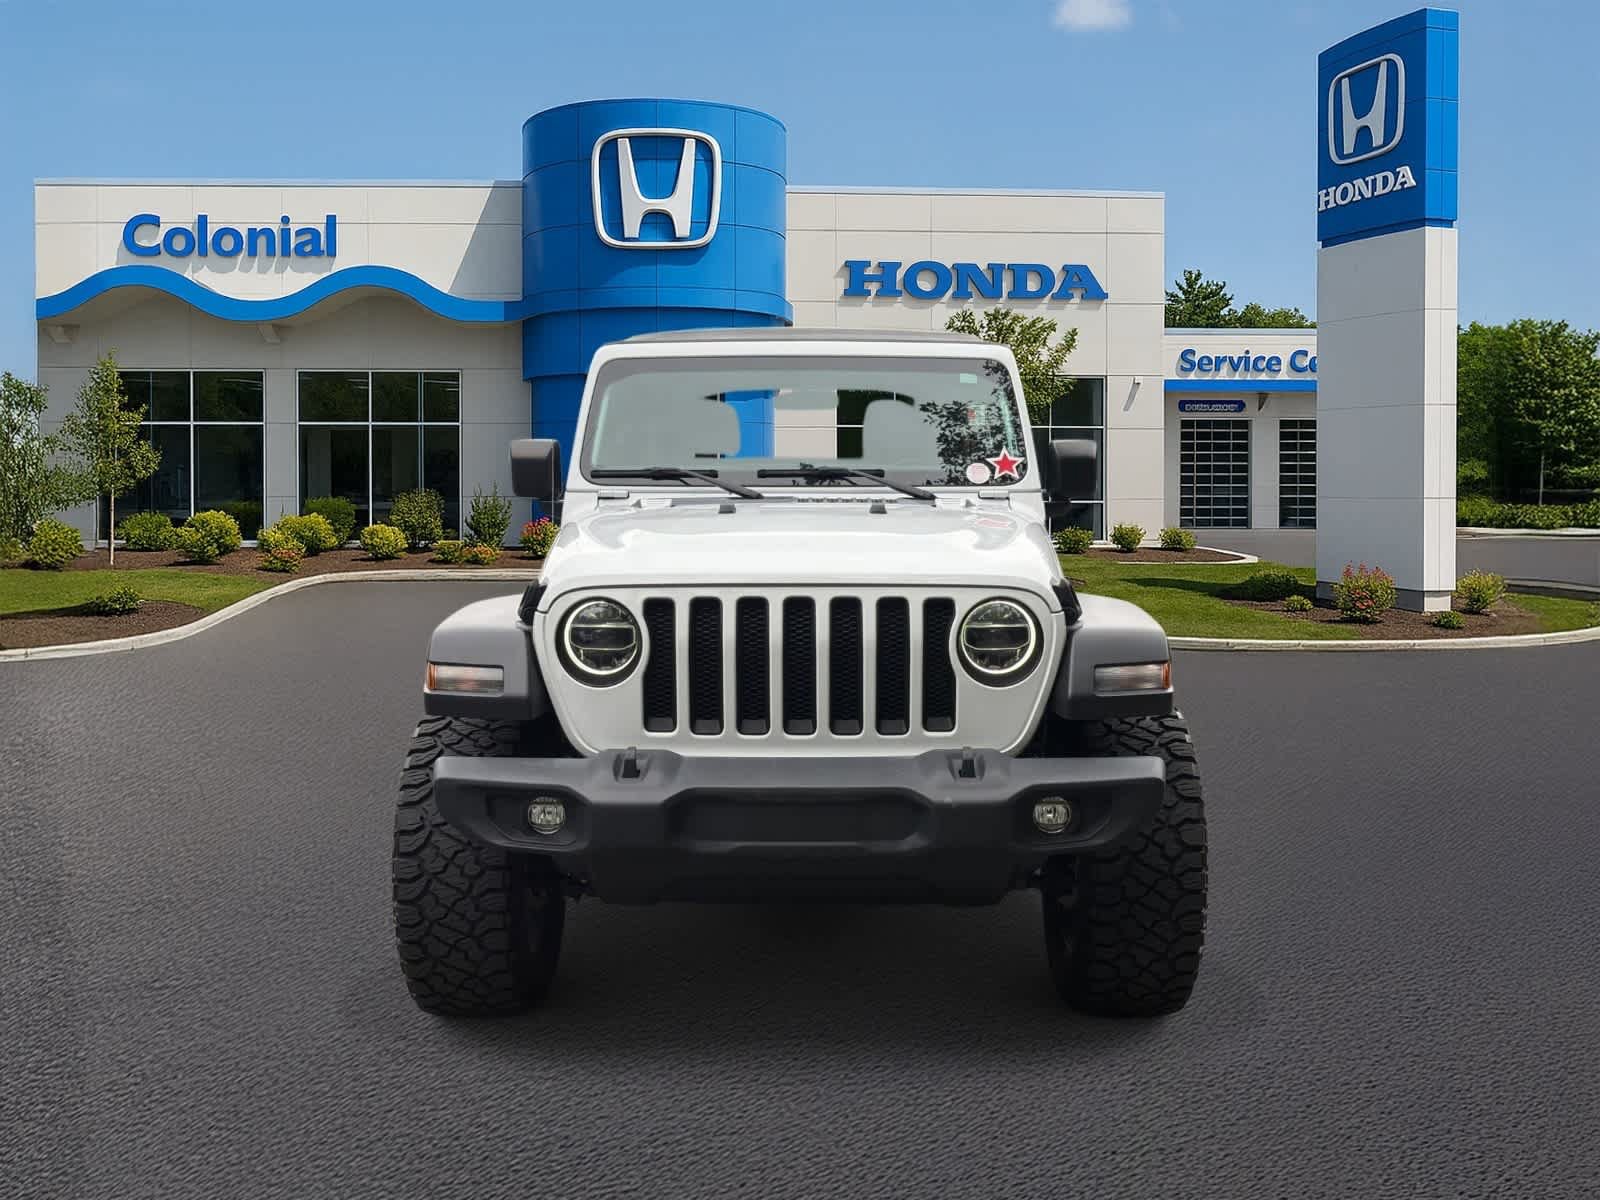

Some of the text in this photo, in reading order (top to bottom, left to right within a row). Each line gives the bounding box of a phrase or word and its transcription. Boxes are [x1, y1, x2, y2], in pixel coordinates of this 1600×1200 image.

[1318, 165, 1417, 212] HONDA
[122, 213, 337, 257] Colonial
[843, 260, 1109, 299] HONDA
[1180, 348, 1282, 373] Service
